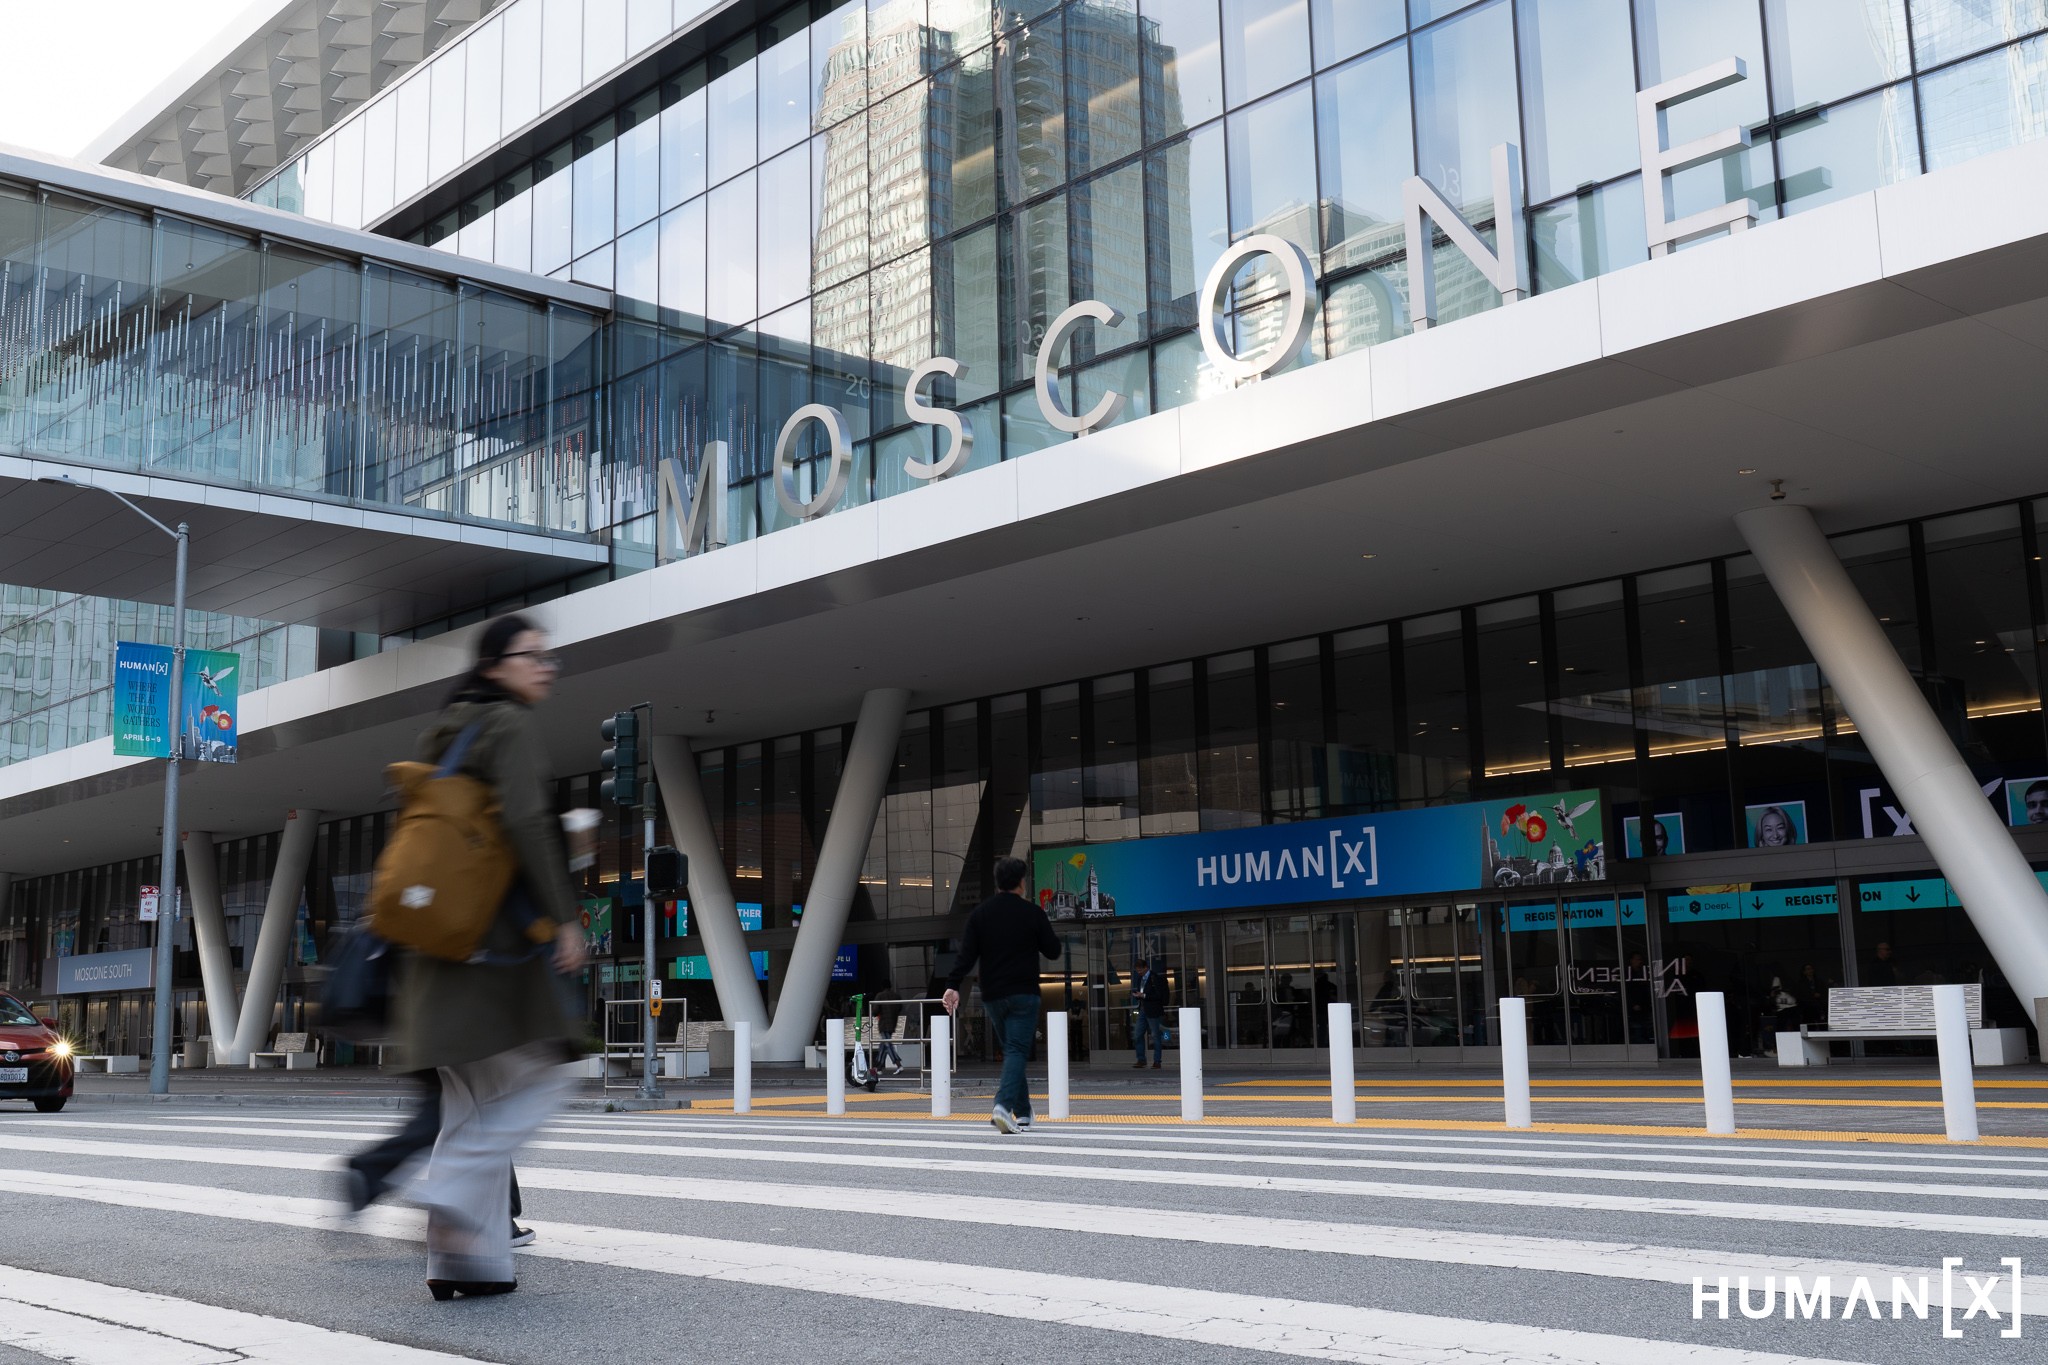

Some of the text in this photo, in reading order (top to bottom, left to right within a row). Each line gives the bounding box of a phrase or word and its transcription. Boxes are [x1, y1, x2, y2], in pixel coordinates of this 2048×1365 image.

[656, 56, 1759, 563] MOSCONE
[120, 661, 168, 676] HUMAN[X]
[128, 681, 157, 693] WHERE
[129, 693, 146, 703] THE
[127, 704, 156, 716] WORLD
[122, 716, 160, 728] GATHERS
[122, 733, 144, 742] APRIL
[1197, 826, 1378, 889] HUMAN[X]
[1704, 901, 1731, 911] DeepL
[1524, 908, 1603, 923] REGISRATION
[75, 963, 132, 982] MOSCONE SOUTH
